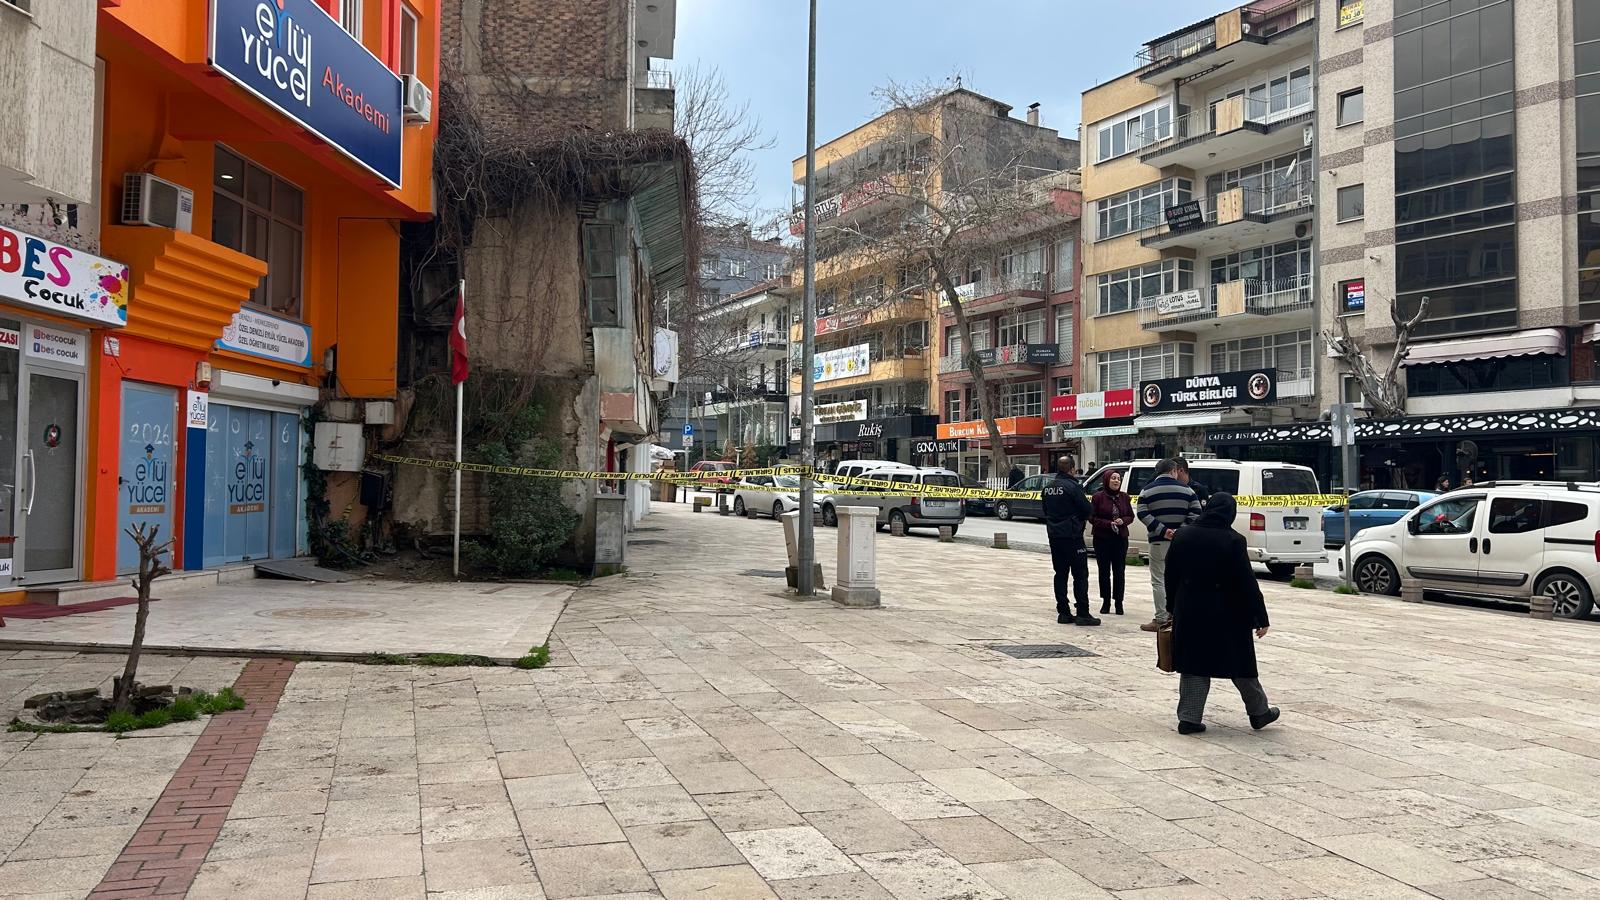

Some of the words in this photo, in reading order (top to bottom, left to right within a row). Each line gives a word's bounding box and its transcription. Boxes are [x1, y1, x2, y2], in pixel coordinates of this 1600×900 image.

[322, 65, 389, 135] Akademi
[0, 228, 73, 287] BES
[24, 279, 85, 310] Çocuk
[41, 331, 76, 346] bescocuk
[41, 345, 55, 354] bes
[56, 349, 78, 359] cocuk
[1185, 376, 1221, 389] DÜNYA
[1170, 390, 1198, 403] TÜRK
[1199, 386, 1237, 400] BİRLİĞİ
[130, 423, 170, 446] 2026
[857, 422, 882, 438] Rukiş
[938, 441, 957, 451] BUTİK
